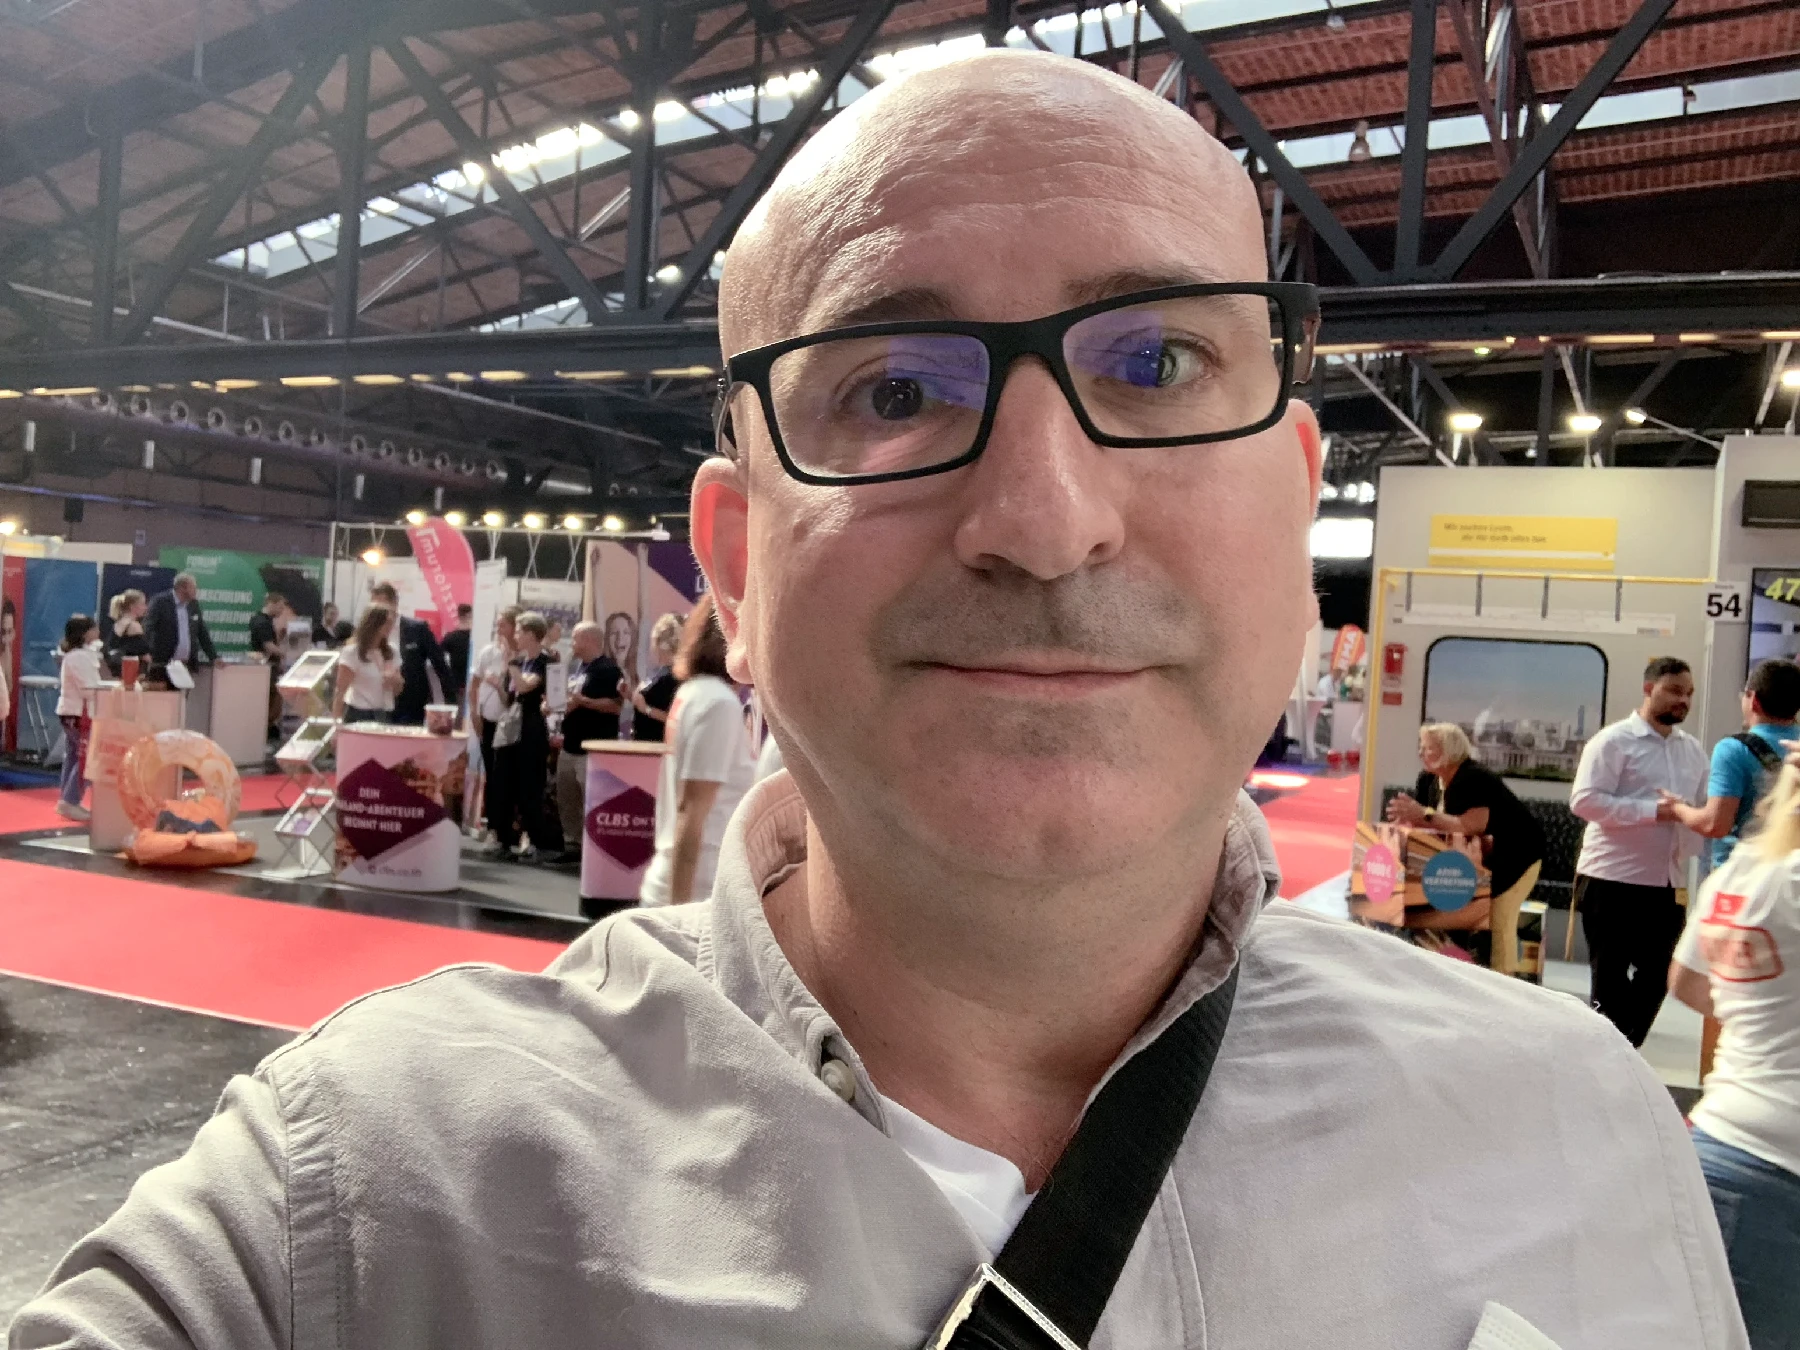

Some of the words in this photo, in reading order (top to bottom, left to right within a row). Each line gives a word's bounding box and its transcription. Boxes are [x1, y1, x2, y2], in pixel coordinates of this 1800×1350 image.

[1706, 593, 1742, 617] 54
[359, 788, 380, 799] DEIN
[597, 812, 630, 827] CLBS
[379, 821, 402, 832] HIER
